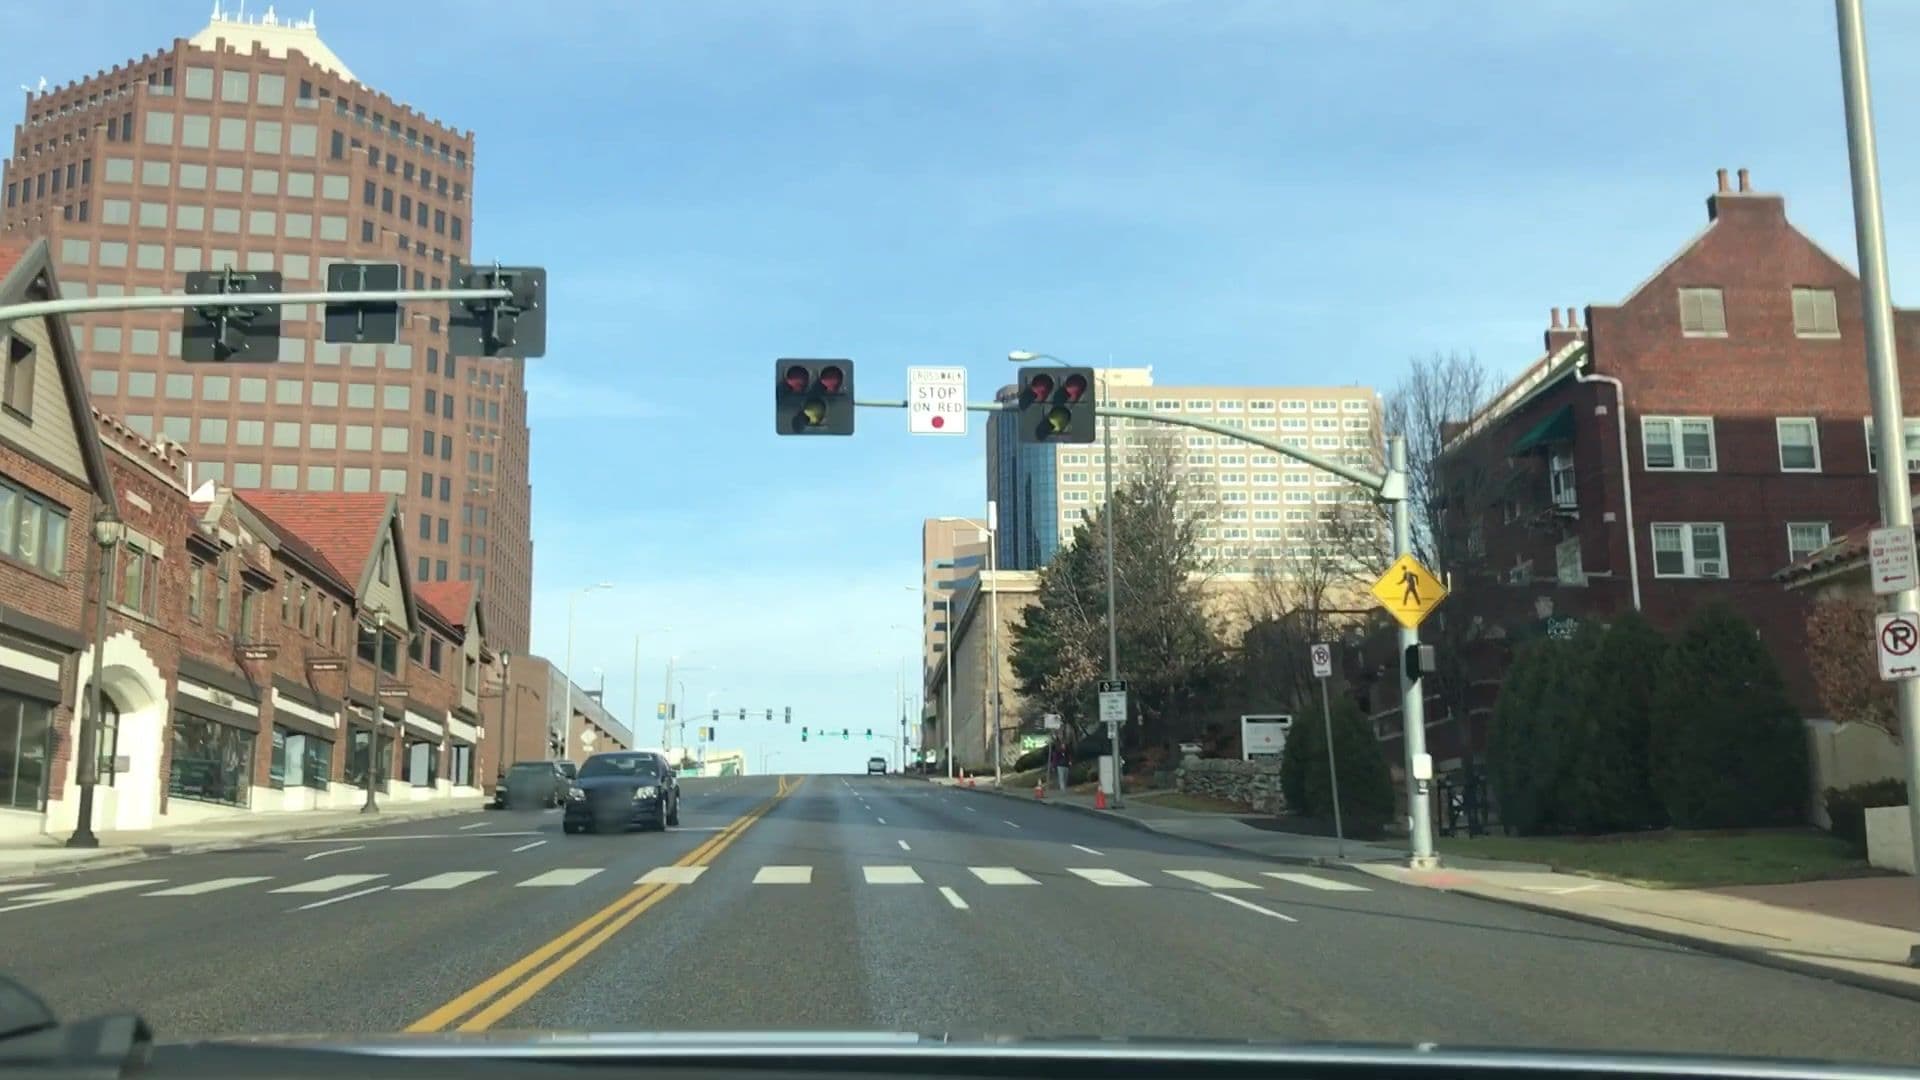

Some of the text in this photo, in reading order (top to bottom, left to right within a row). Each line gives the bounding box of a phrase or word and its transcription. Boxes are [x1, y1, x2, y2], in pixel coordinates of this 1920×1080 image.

[918, 387, 957, 399] STOP
[913, 402, 962, 413] ON RED
